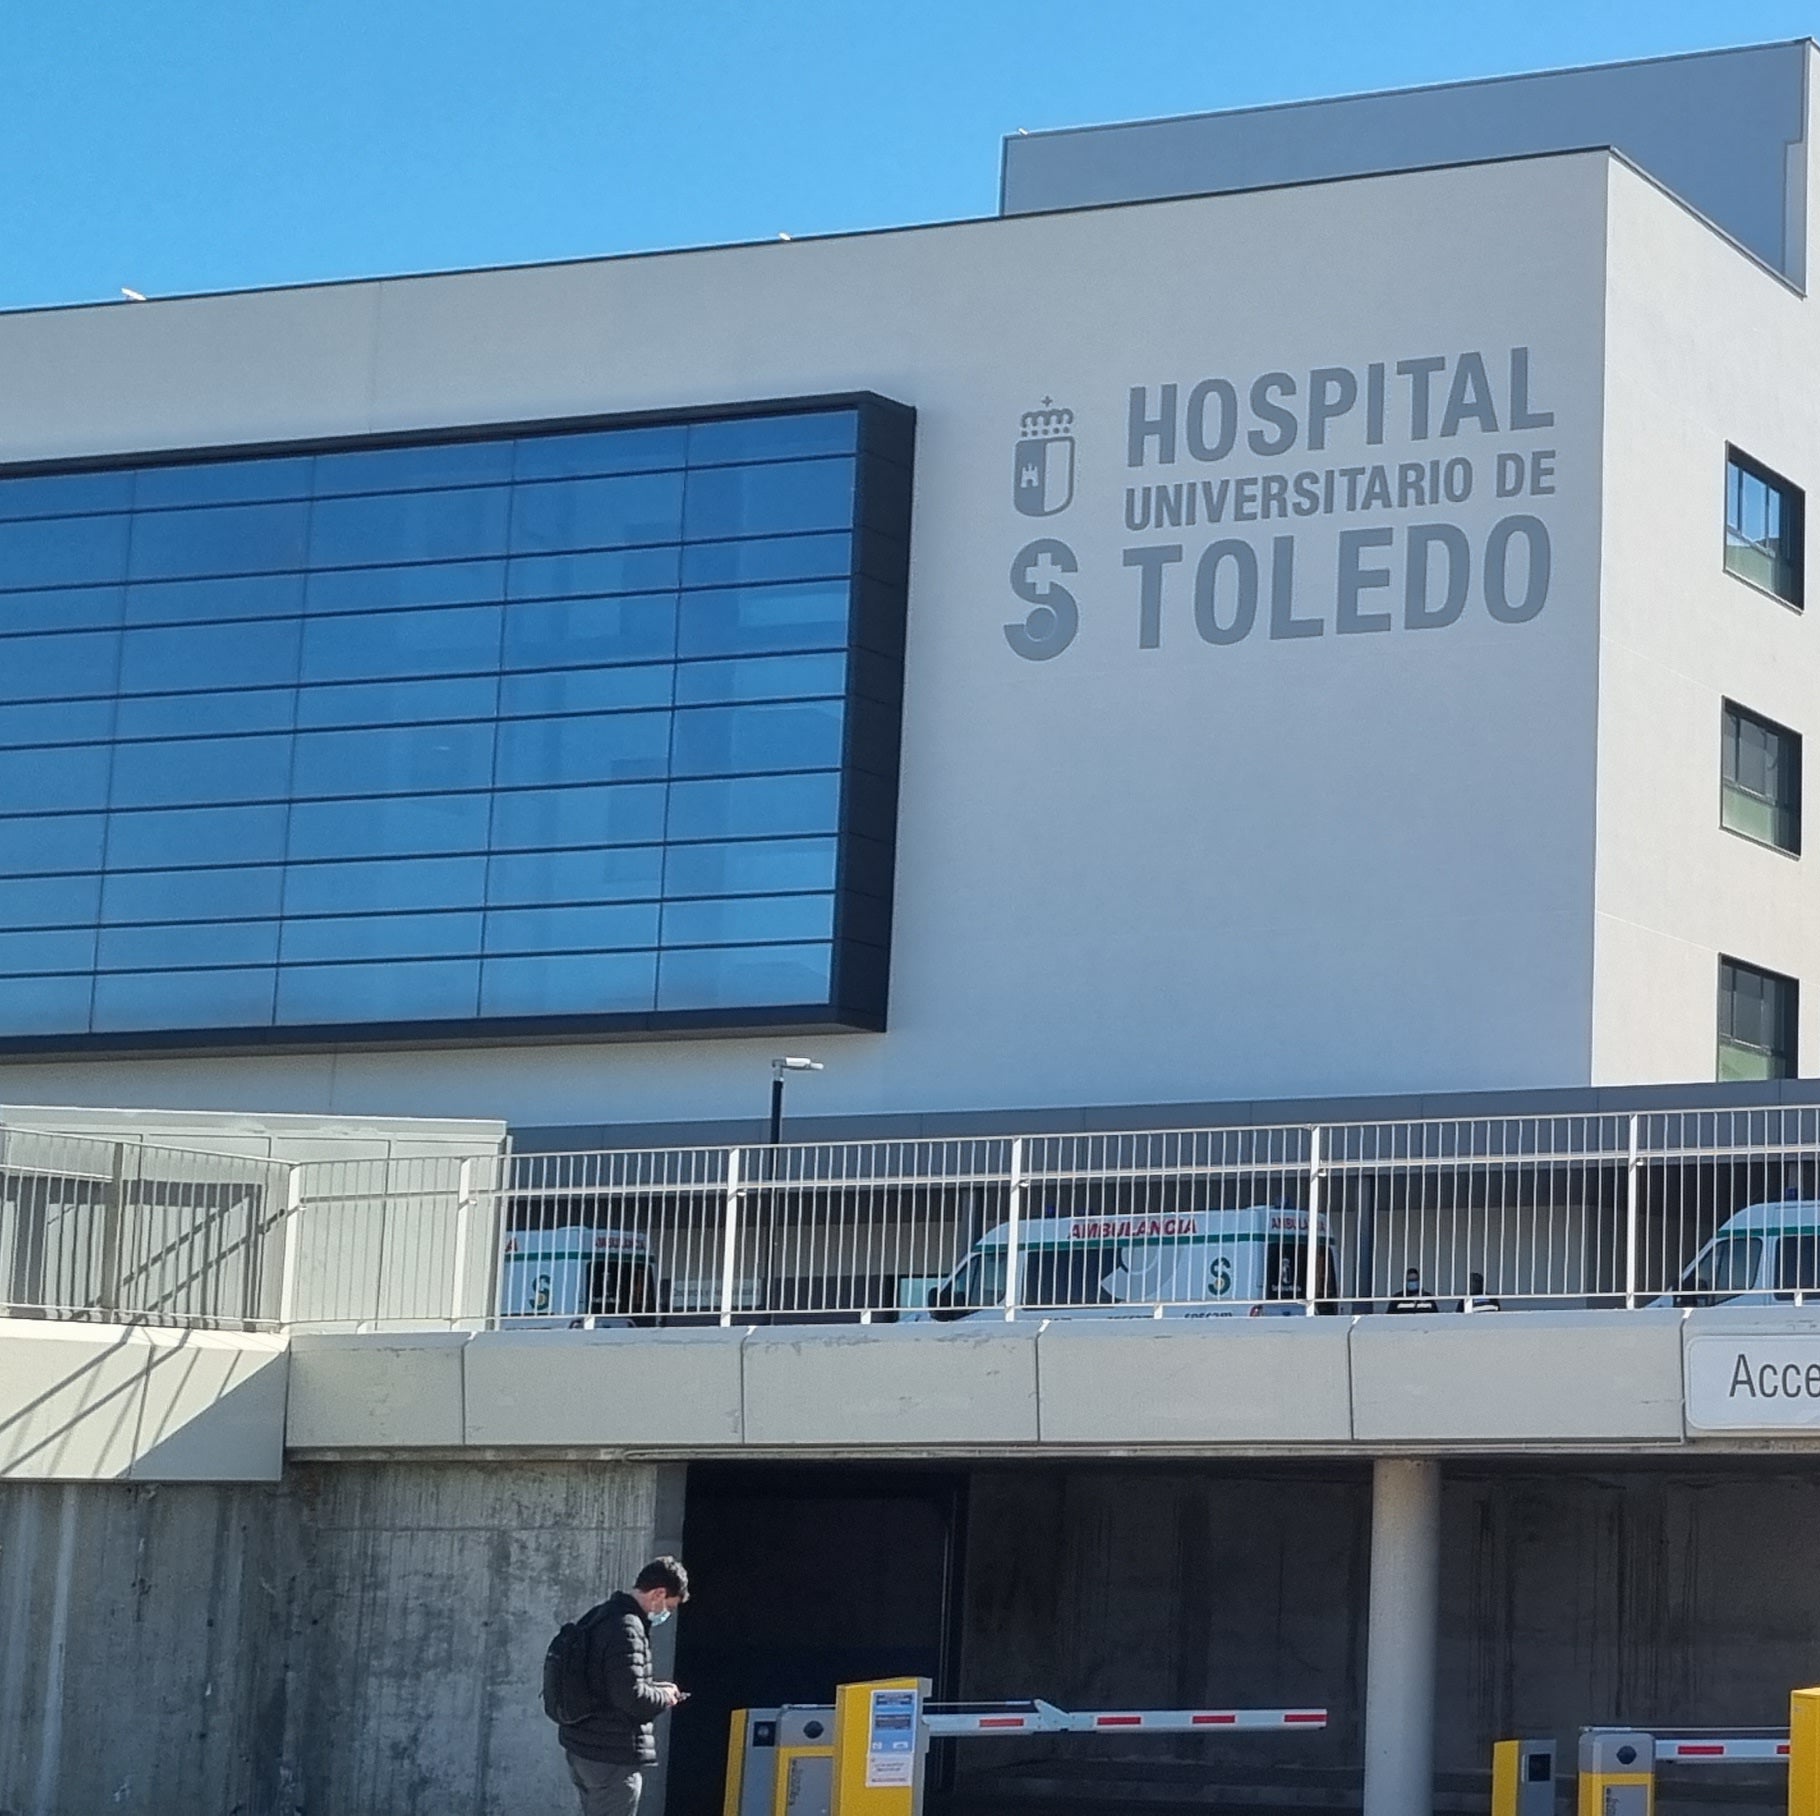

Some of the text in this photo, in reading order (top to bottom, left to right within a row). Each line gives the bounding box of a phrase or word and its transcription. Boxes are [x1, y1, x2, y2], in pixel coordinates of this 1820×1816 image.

[1127, 346, 1555, 468] HOSPITAL
[1124, 449, 1557, 531] UNIVERSITARIO DE
[1122, 514, 1552, 649] TOLEDO
[1067, 1218, 1197, 1240] AMBULANCIA
